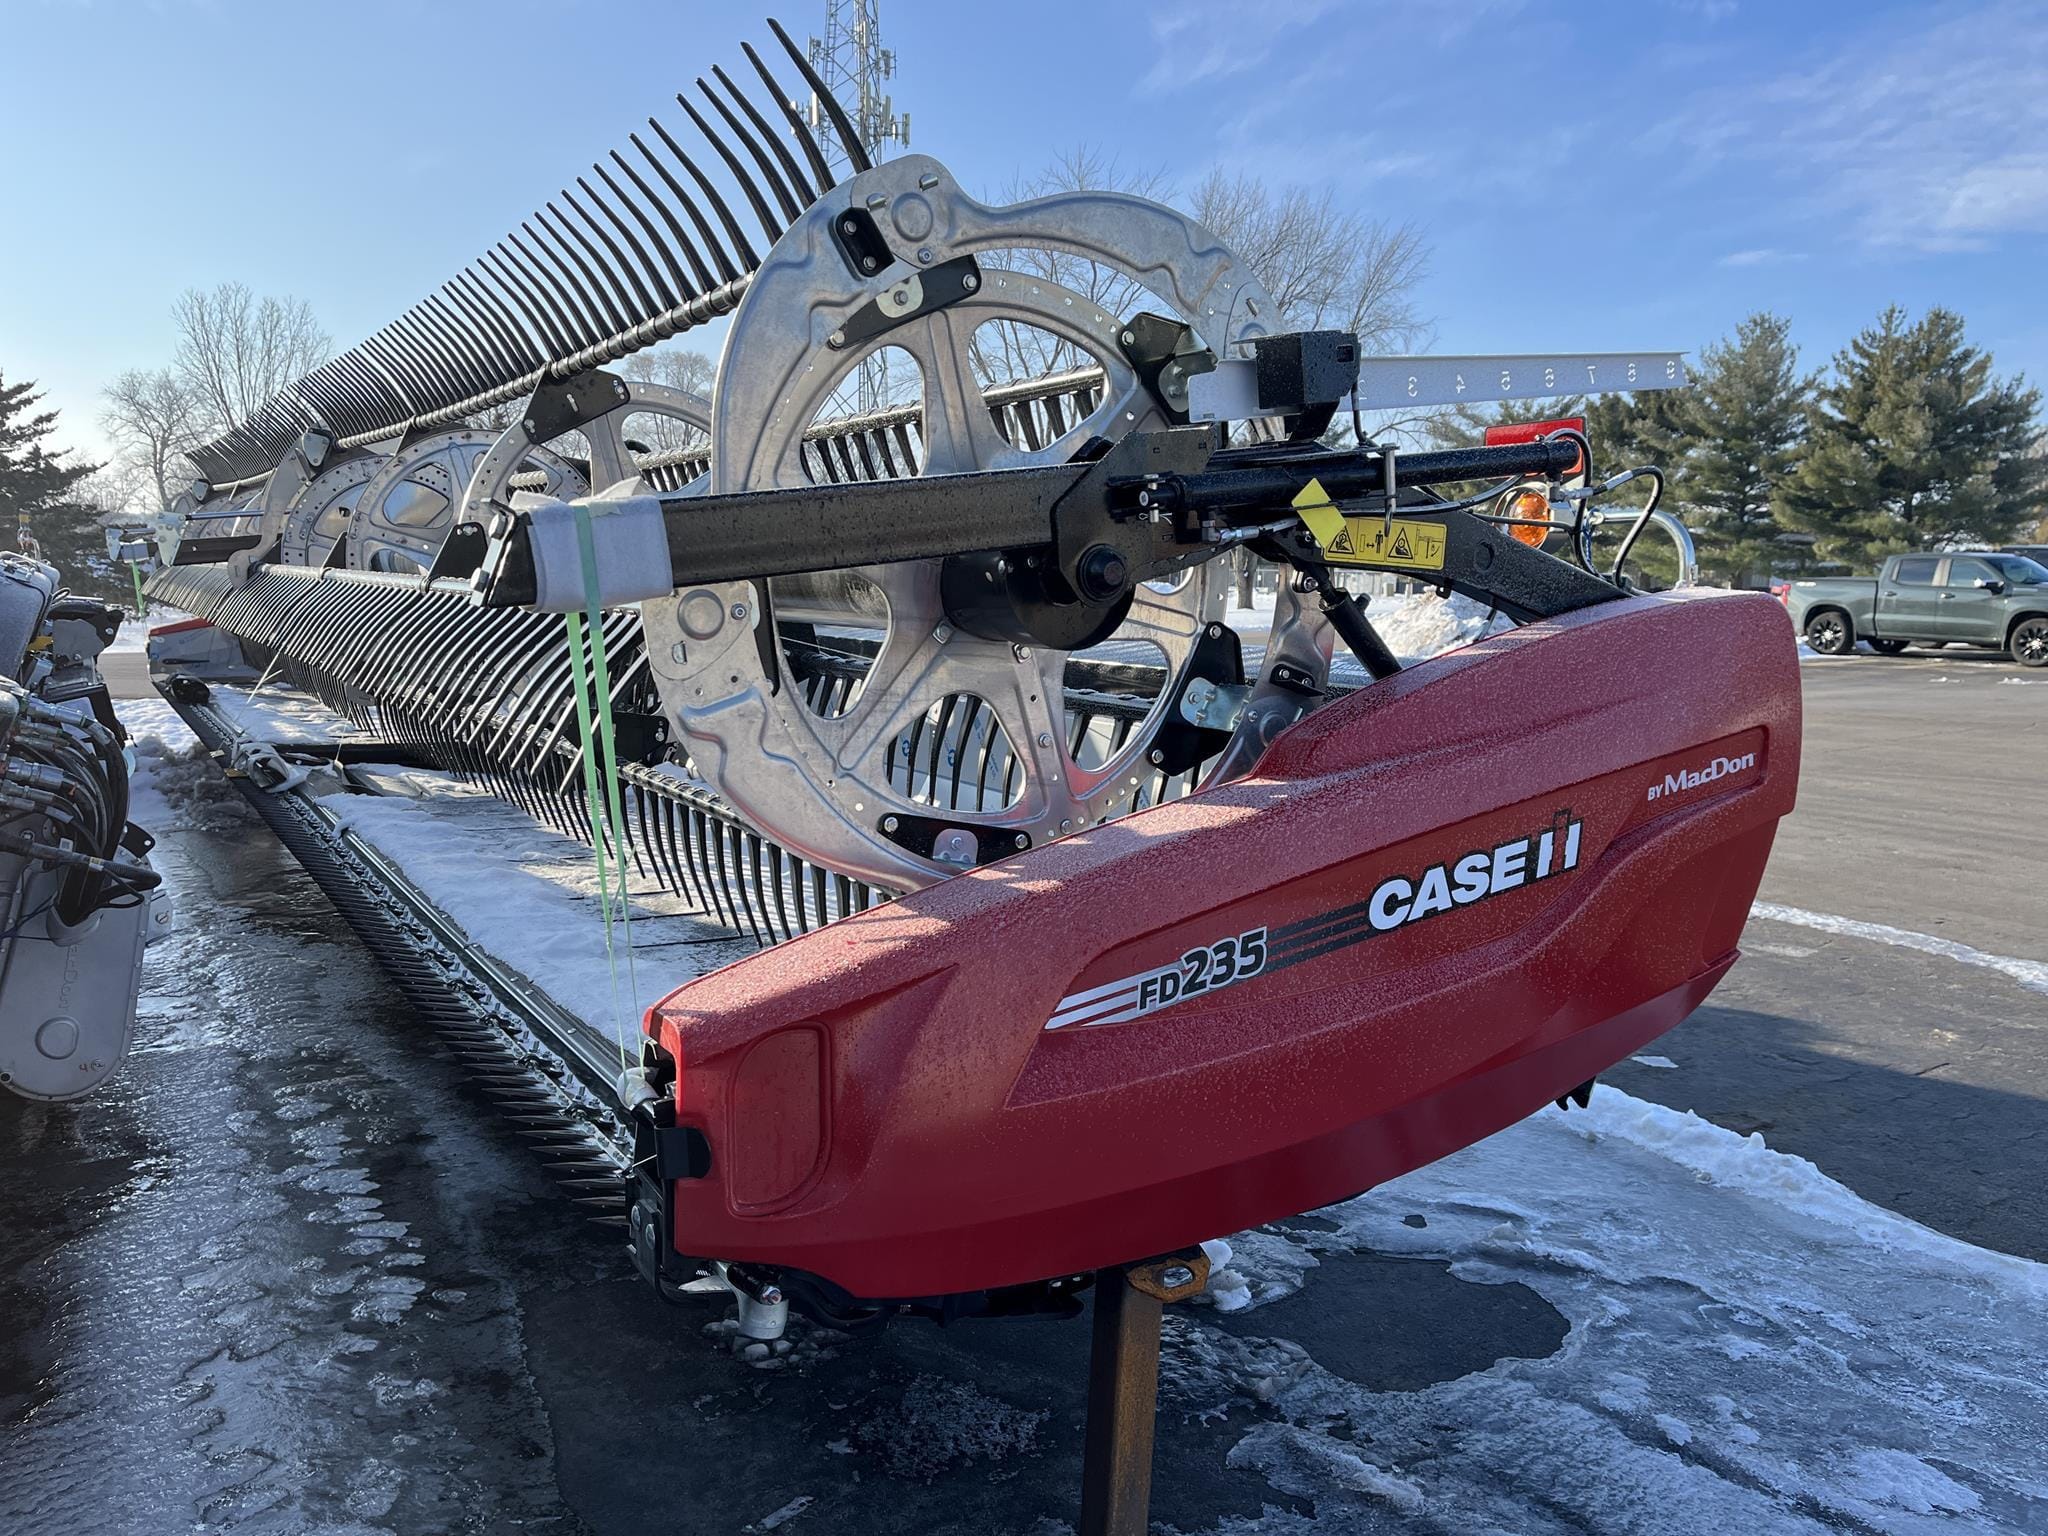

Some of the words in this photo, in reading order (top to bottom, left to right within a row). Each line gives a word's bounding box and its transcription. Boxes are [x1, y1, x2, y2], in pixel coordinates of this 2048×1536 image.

[1647, 783, 1663, 801] BY
[1665, 752, 1755, 796] MacDon
[1369, 839, 1528, 932] CASE
[1137, 926, 1269, 1014] FD235
